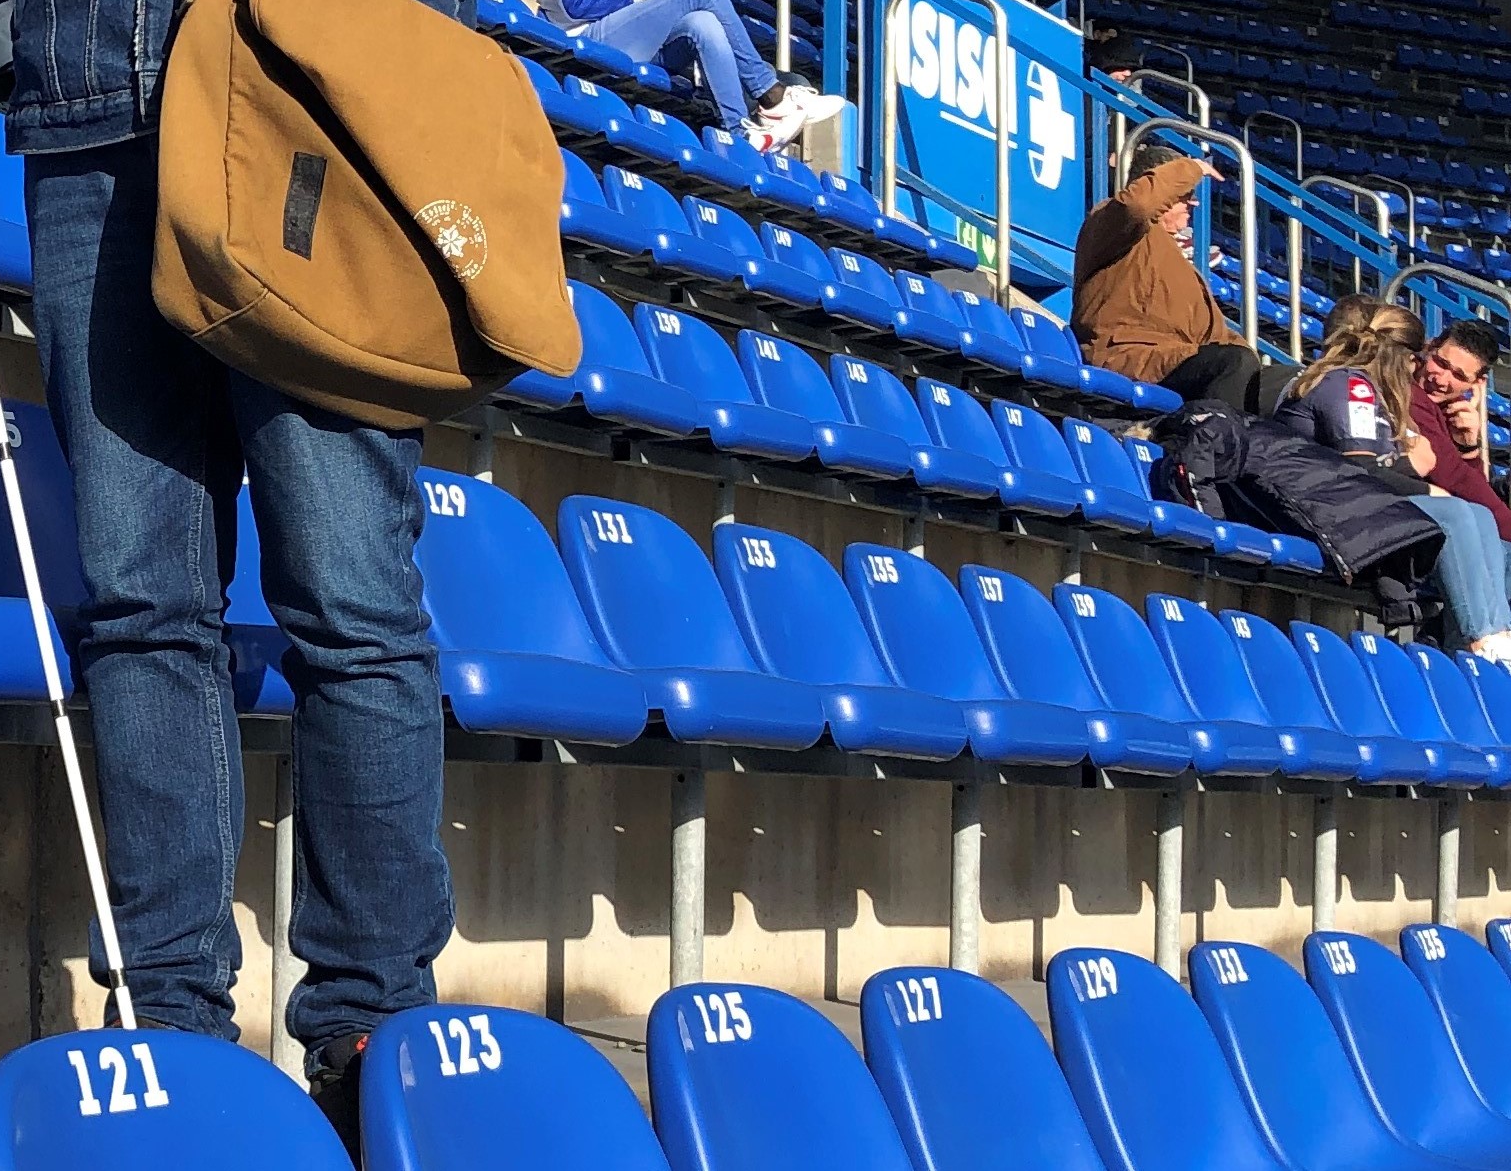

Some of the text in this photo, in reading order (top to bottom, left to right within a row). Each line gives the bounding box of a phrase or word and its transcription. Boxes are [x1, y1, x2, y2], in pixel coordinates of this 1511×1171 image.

[619, 169, 643, 190] 145
[698, 204, 717, 224] 147
[841, 254, 861, 273] 151
[654, 310, 681, 335] 139
[755, 337, 781, 362] 141
[845, 361, 868, 383] 143
[930, 384, 951, 406] 145
[1004, 406, 1023, 427] 147
[423, 481, 466, 517] 129
[592, 510, 633, 544] 131
[742, 537, 776, 568] 133
[868, 555, 899, 583] 135
[978, 575, 1003, 602] 137
[1071, 593, 1096, 617] 139
[1160, 598, 1184, 622] 141
[1324, 940, 1357, 975] 133
[1416, 928, 1446, 961] 135
[1077, 956, 1118, 1002] 129
[1210, 947, 1249, 985] 131
[896, 976, 942, 1023] 127
[693, 991, 752, 1043] 125
[429, 1015, 501, 1075] 123
[68, 1043, 169, 1115] 121
